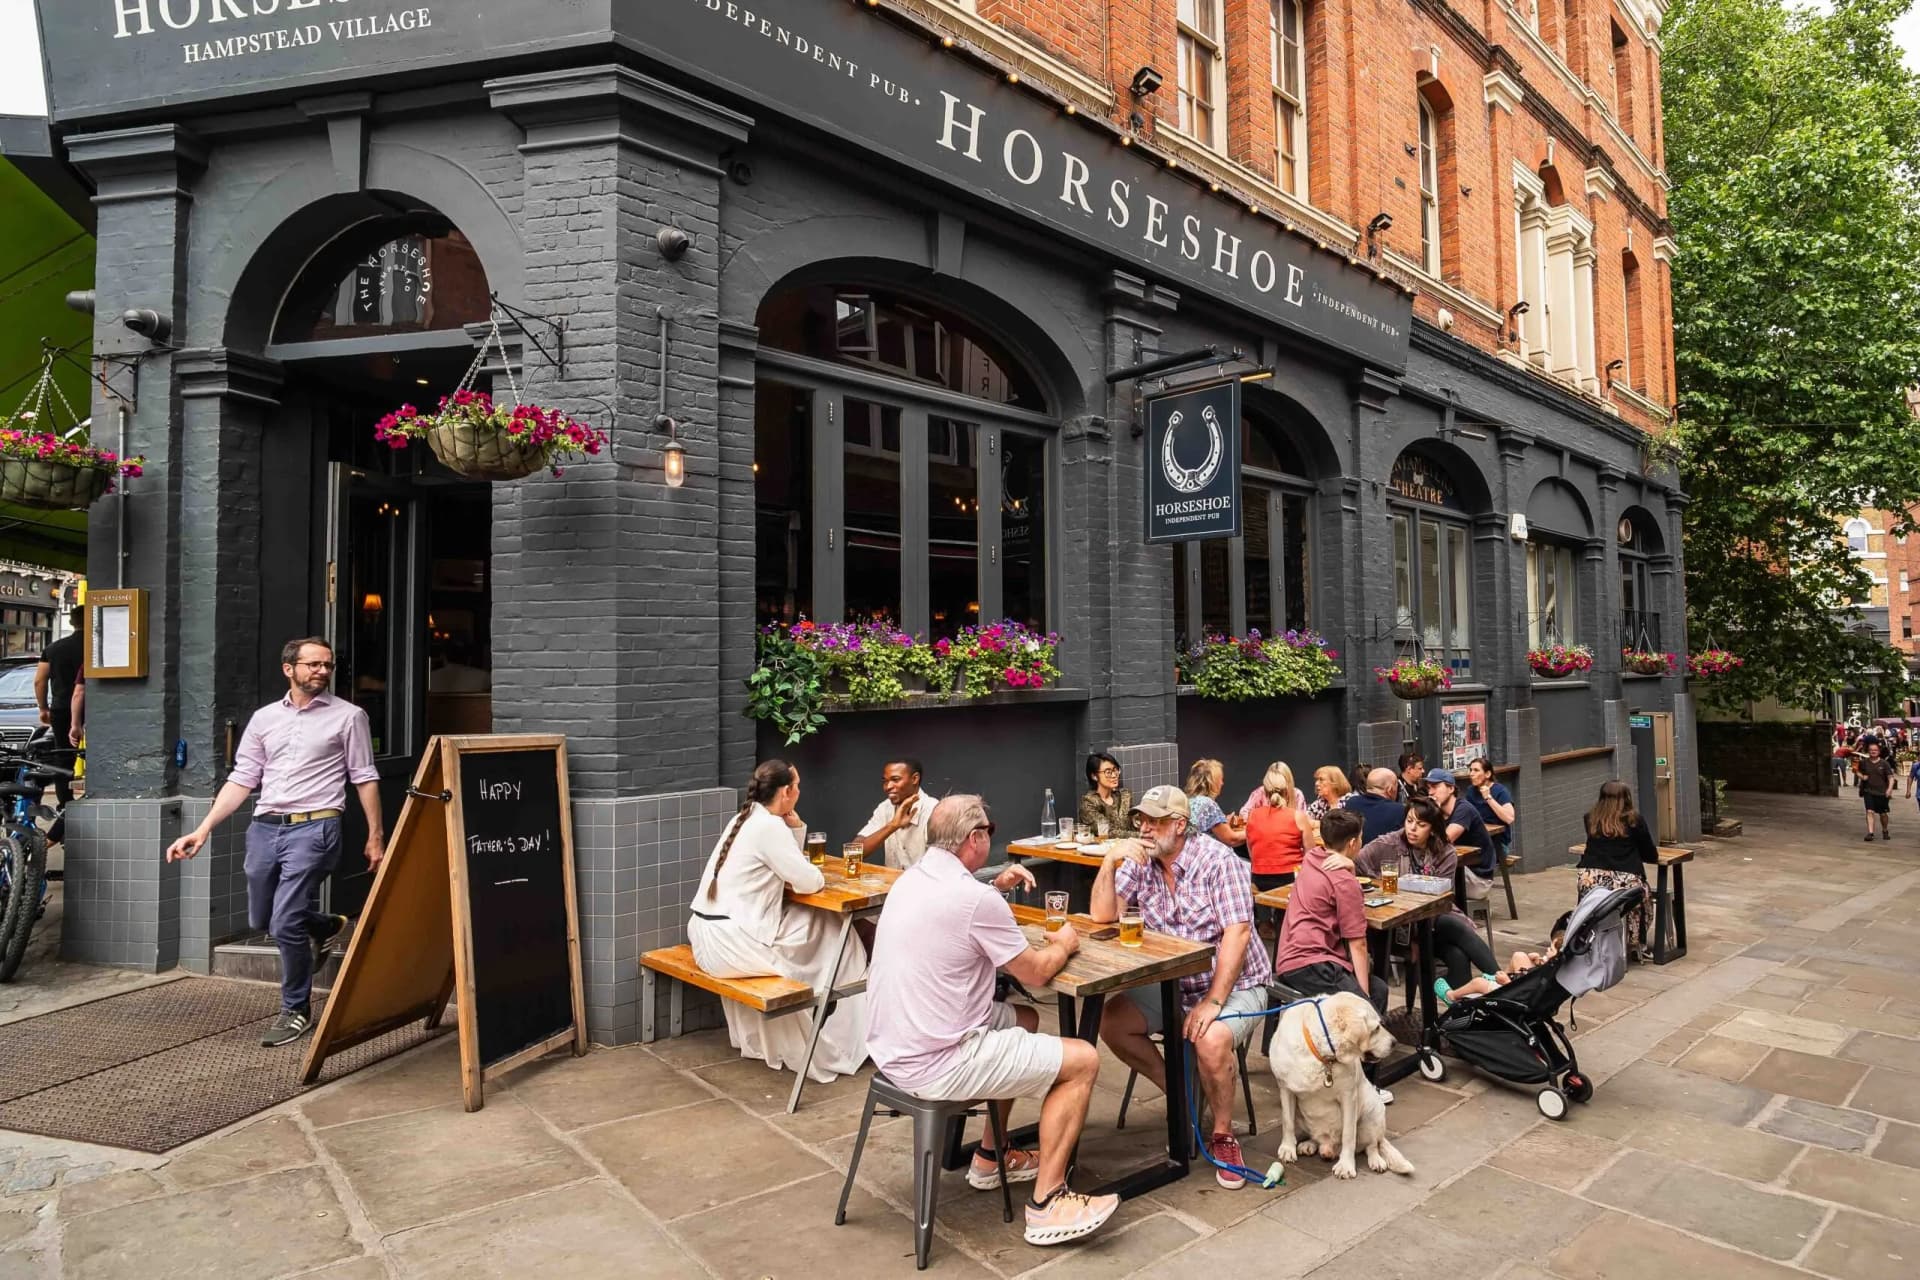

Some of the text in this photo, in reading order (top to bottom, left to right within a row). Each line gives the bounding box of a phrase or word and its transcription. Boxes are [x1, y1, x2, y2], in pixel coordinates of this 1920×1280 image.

[184, 8, 431, 63] HAMPSTEAD VILLAGE
[693, 0, 858, 79] DEPENDENT
[936, 90, 1304, 307] HORSESHOE
[1394, 479, 1443, 504] THEATRE
[1156, 496, 1231, 516] HORSESHOE
[1165, 512, 1220, 525] INDEPENDENT PUB
[480, 778, 522, 801] HAPPY
